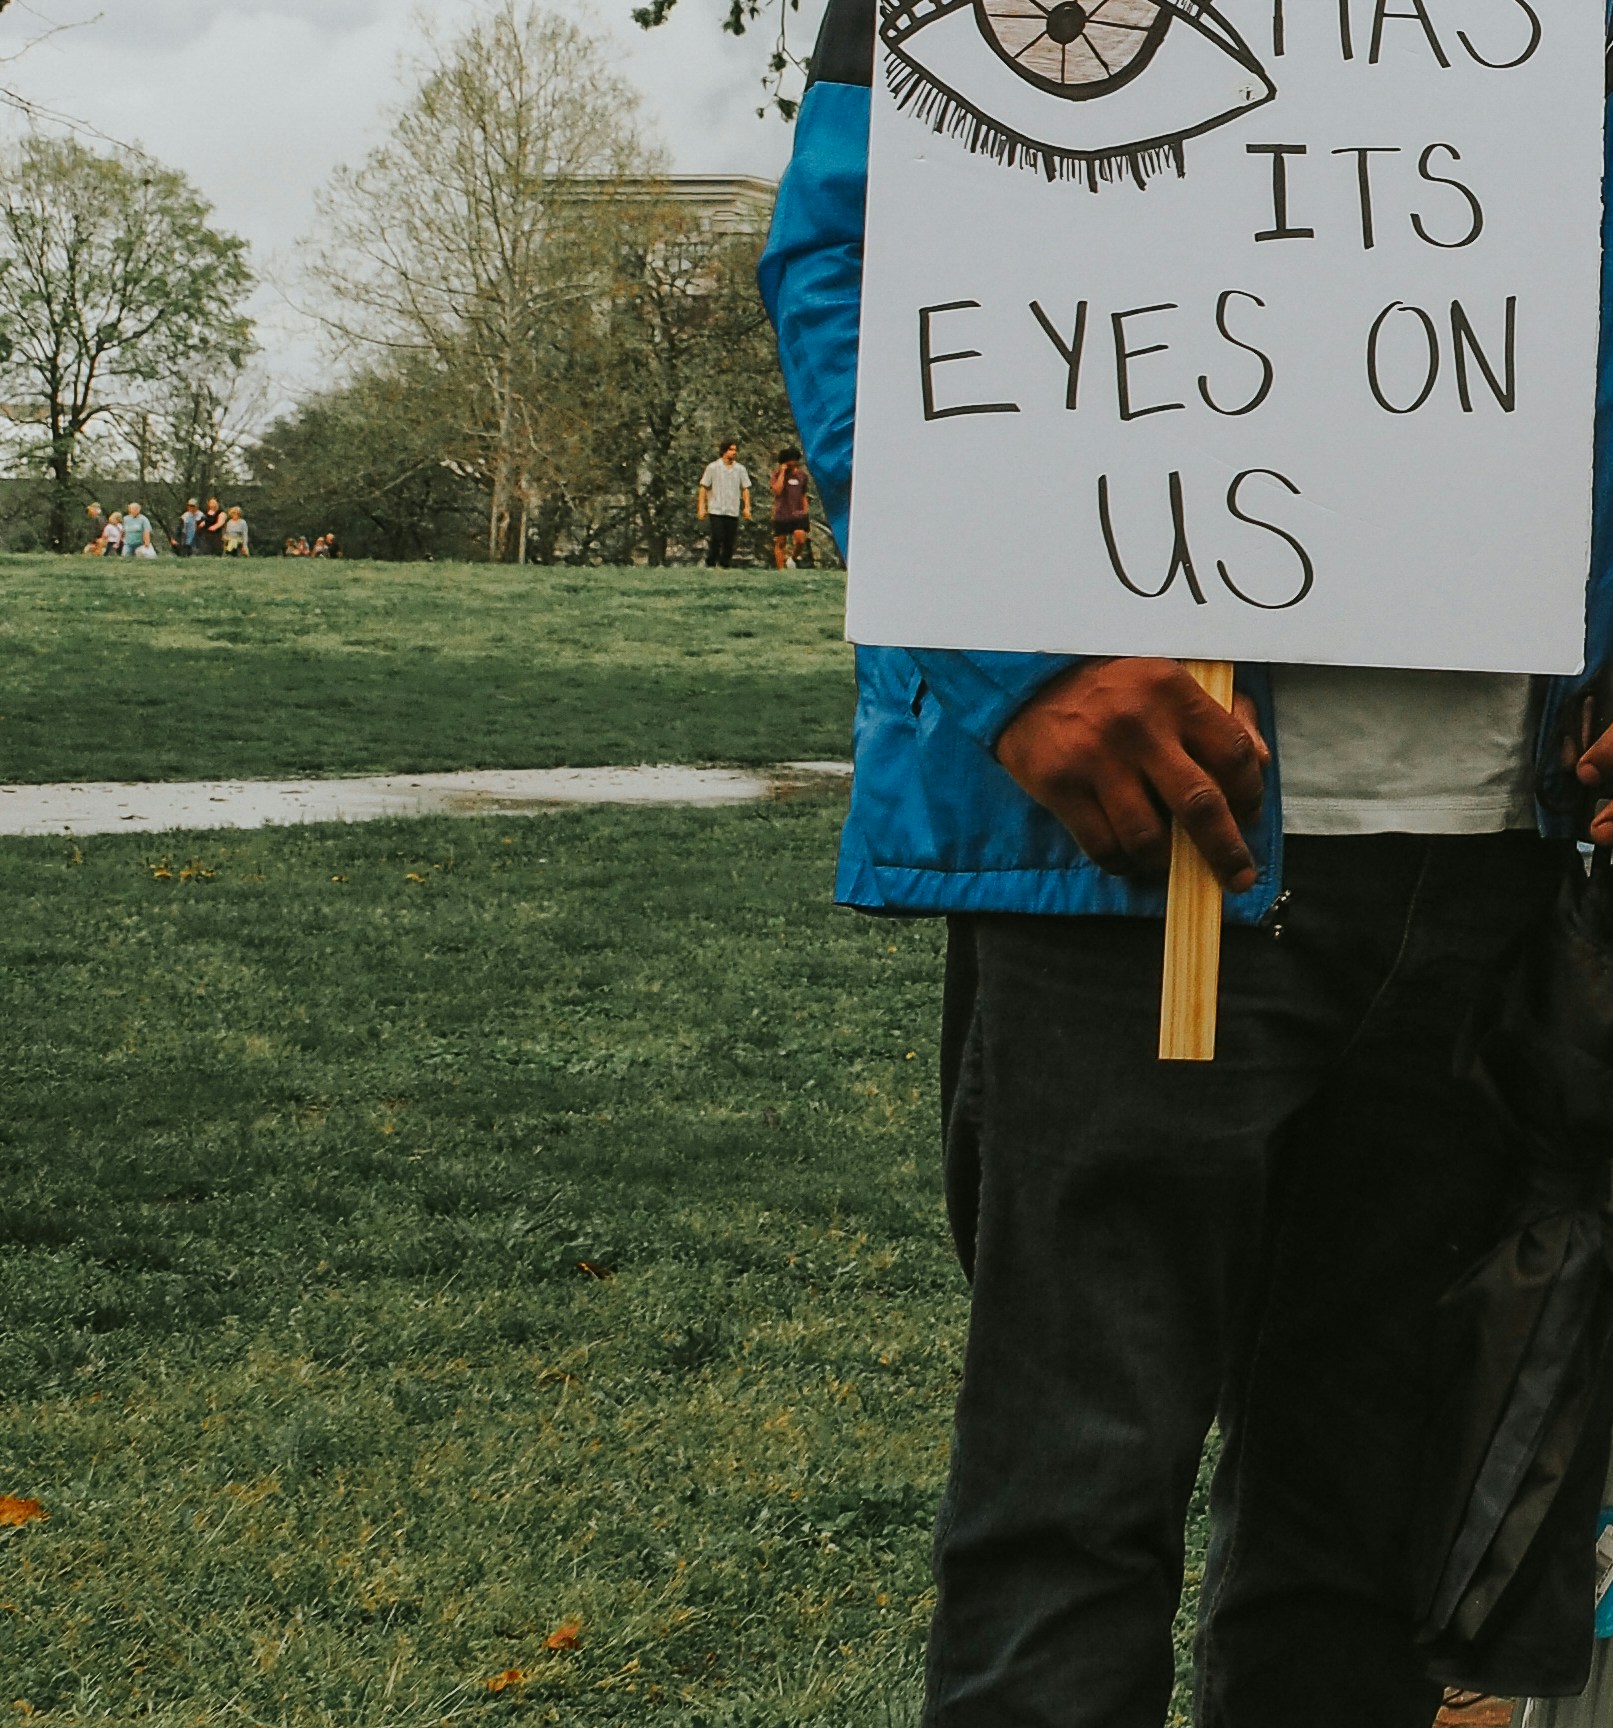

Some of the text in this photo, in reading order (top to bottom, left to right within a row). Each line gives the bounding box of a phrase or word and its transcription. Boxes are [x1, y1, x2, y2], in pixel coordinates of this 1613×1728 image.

[1244, 142, 1485, 250] ITS
[917, 289, 1517, 423] EYES ON
[1096, 468, 1316, 611] US
